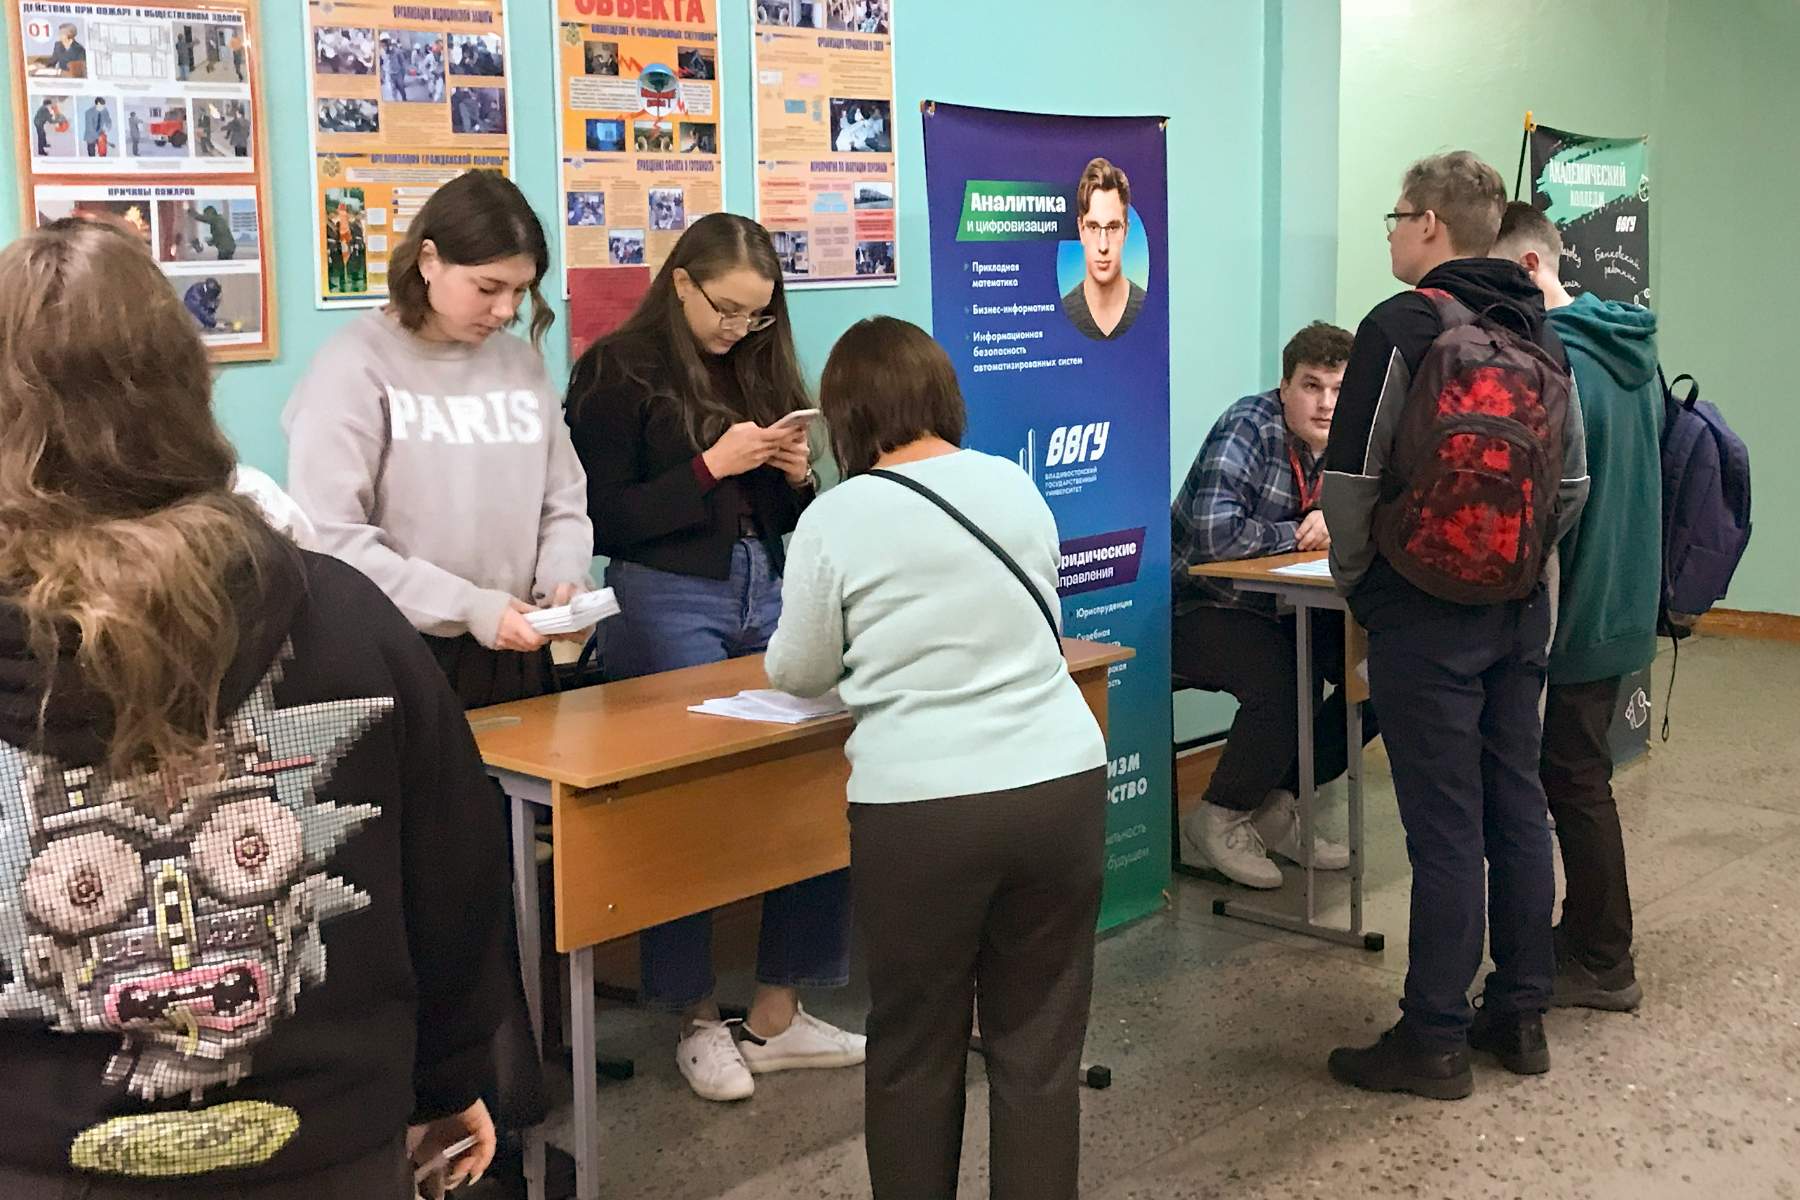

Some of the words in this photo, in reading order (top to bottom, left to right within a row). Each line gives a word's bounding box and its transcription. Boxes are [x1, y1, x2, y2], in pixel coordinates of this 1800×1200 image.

[75, 5, 93, 14] ПРИ
[28, 23, 50, 37] 01
[1549, 158, 1626, 187] АКАДЕМИЧЕСКИЙ
[108, 187, 151, 196] ПРИЧИНЫ
[155, 187, 195, 196] ПОЖАРОВ
[971, 192, 1066, 212] Аналитика
[967, 221, 974, 231] и
[976, 220, 1057, 234] цифровизация
[972, 261, 1020, 275] Прикладная
[972, 279, 1019, 288] математика
[972, 303, 1055, 316] Бизнес-информатика
[973, 331, 1043, 344] Информационная
[973, 347, 1027, 357] безопасность
[973, 359, 1057, 372] автоматизированных
[1058, 357, 1083, 366] систем
[385, 385, 543, 444] PARIS
[1045, 421, 1110, 467] ВВГУ
[1060, 542, 1137, 570] ридические
[1057, 567, 1114, 588] правления
[1076, 600, 1133, 618] Юриспруденция
